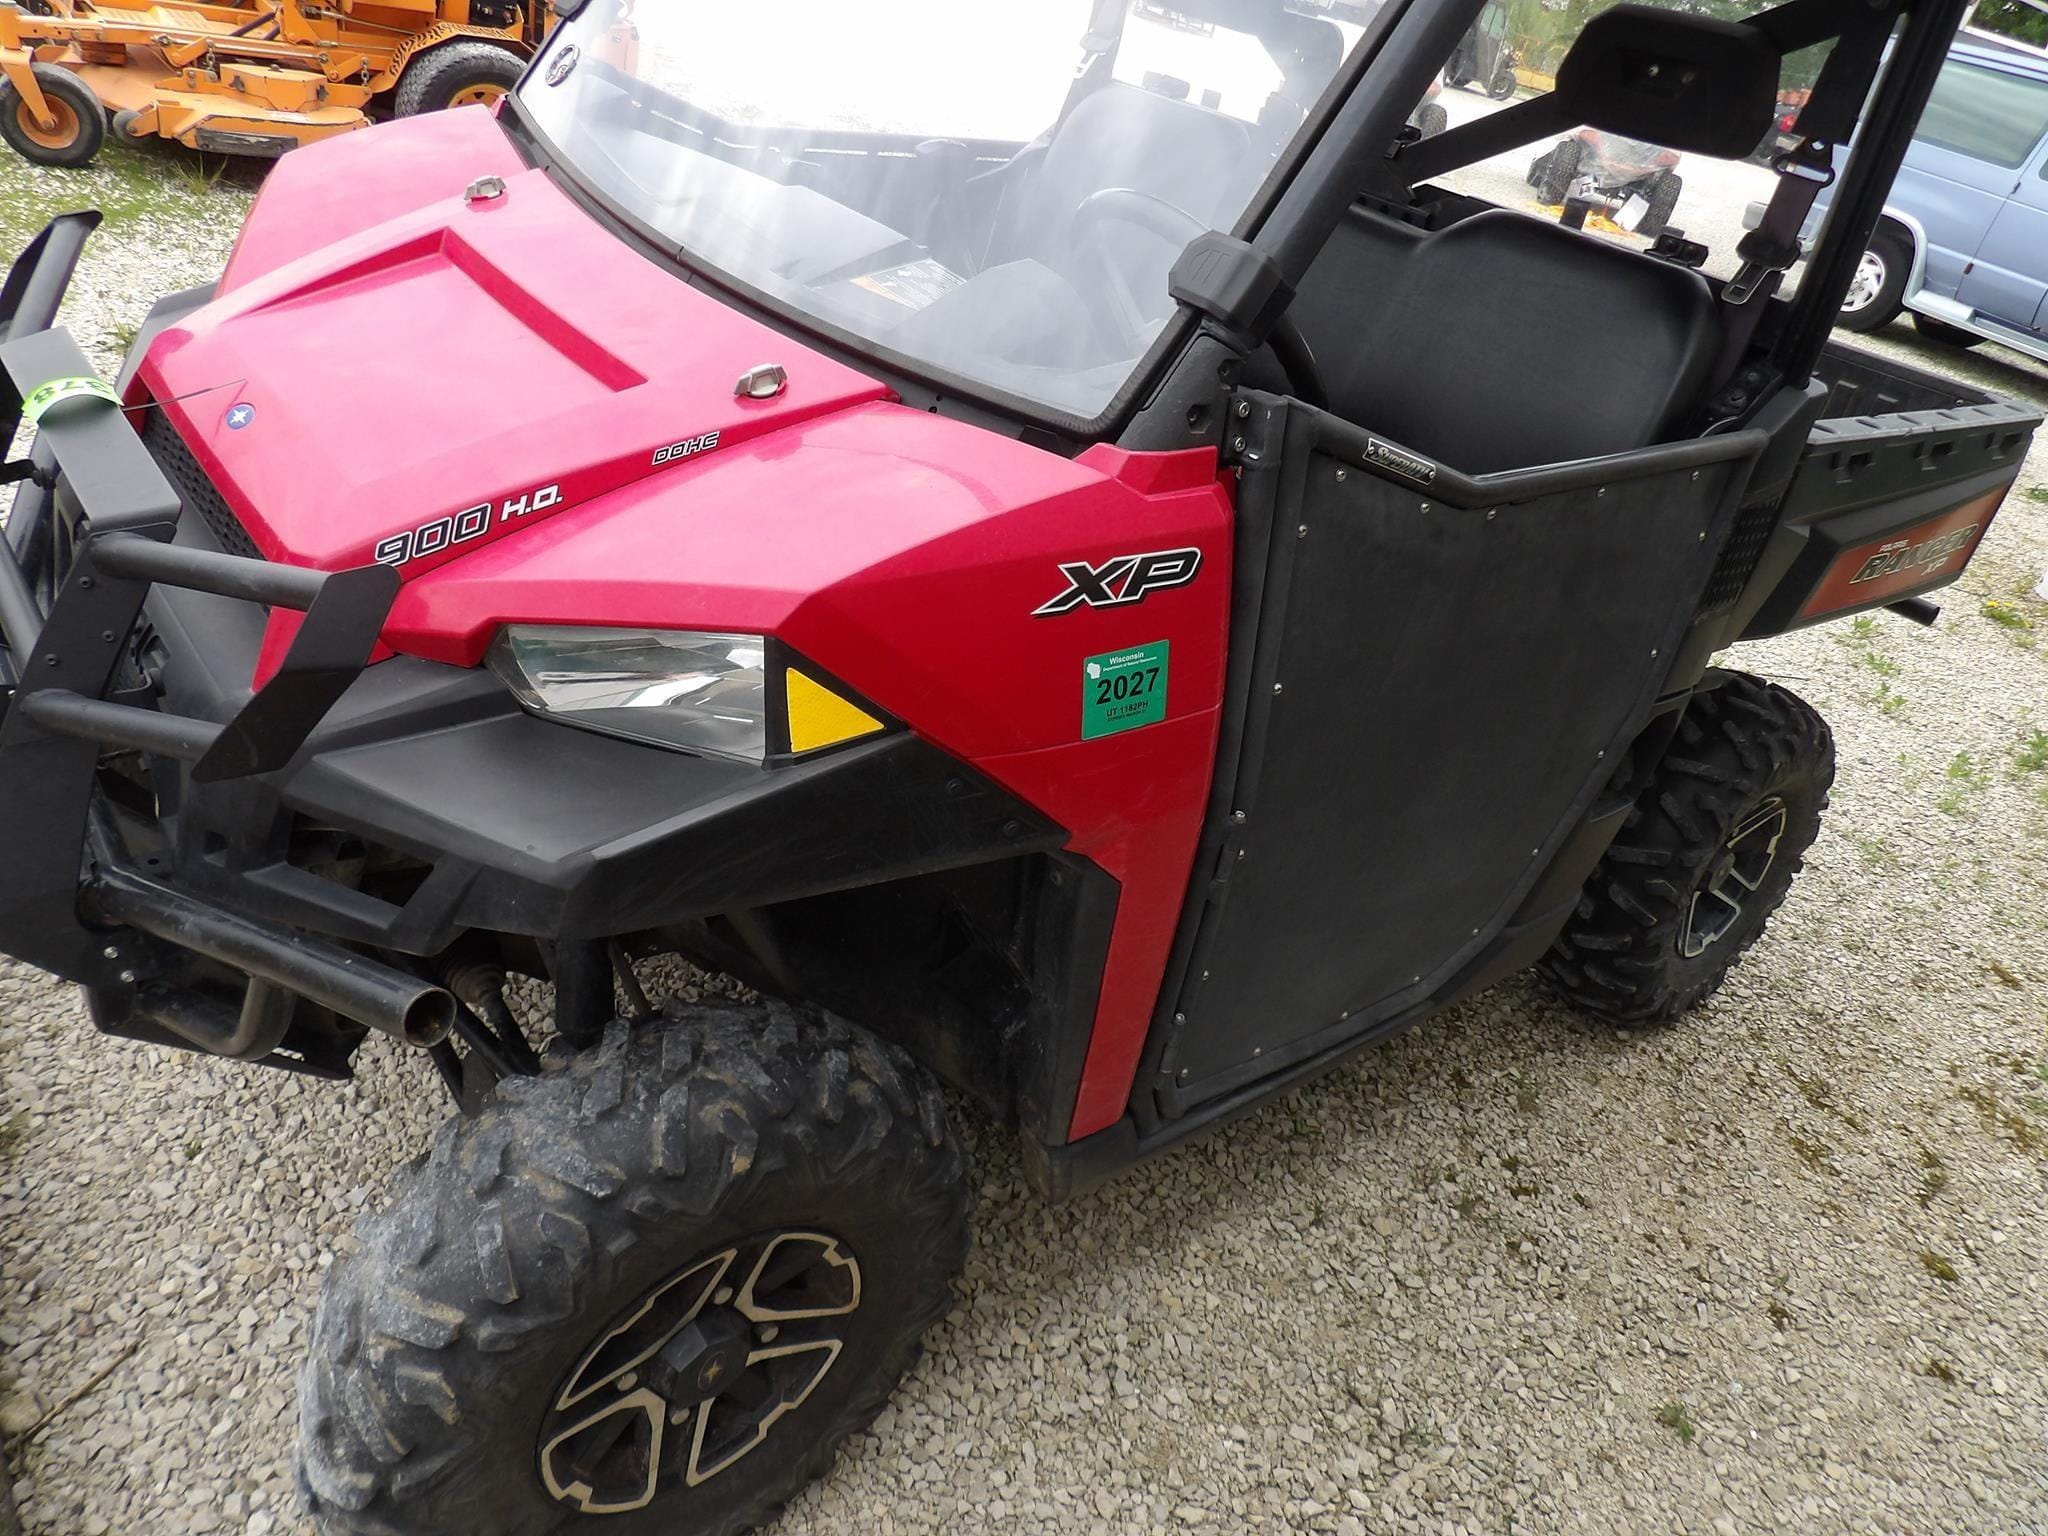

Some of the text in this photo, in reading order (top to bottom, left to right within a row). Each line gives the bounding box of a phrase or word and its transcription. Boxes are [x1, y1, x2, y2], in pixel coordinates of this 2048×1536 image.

[652, 431, 720, 466] DOHC
[375, 485, 563, 567] 900 H.O.
[1848, 523, 1979, 585] RANGER
[1921, 556, 1949, 576] XP
[1030, 547, 1201, 615] XP
[1109, 651, 1145, 665] Wisconsin
[1096, 667, 1160, 705] 2027
[1106, 707, 1118, 717] UT
[1120, 700, 1149, 714] 1182PH
